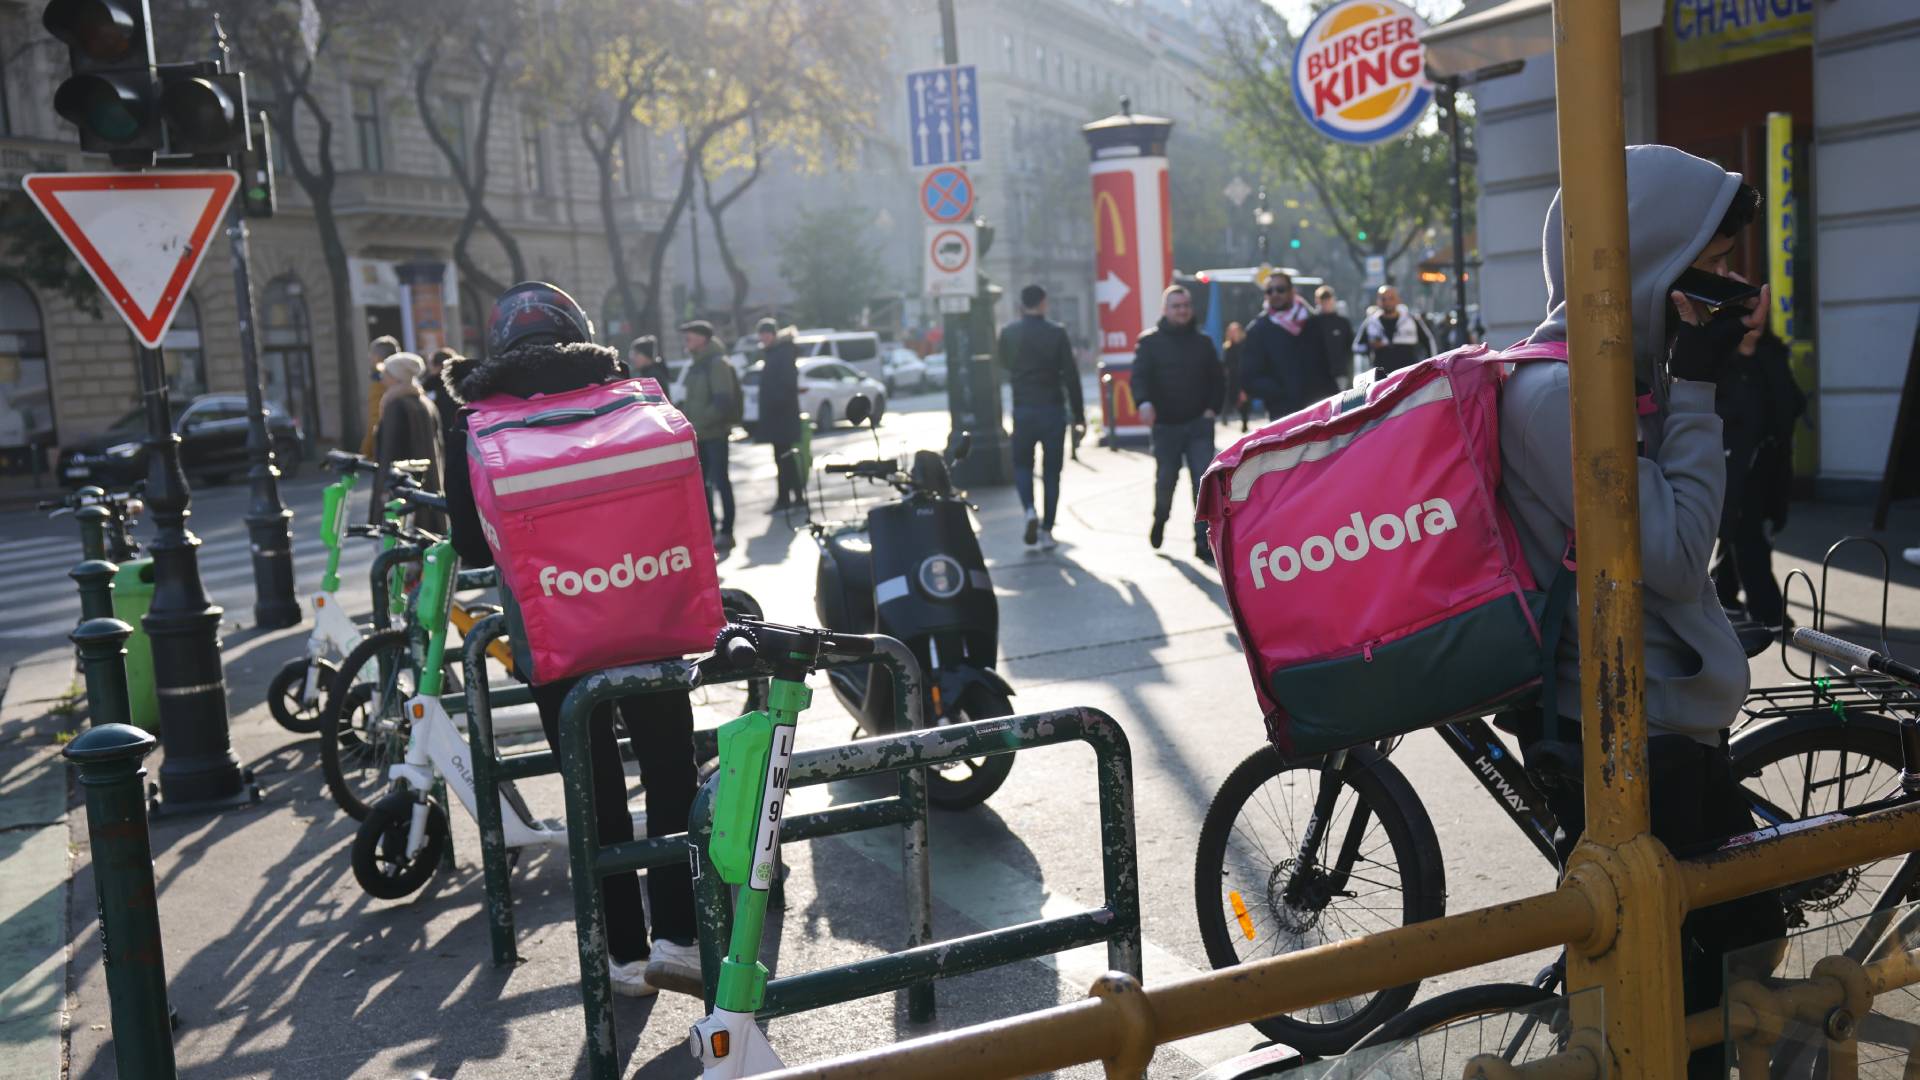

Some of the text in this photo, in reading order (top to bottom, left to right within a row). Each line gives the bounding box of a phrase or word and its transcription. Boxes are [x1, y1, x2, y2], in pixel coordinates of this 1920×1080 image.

[1307, 17, 1414, 81] BURGER
[1674, 0, 1812, 42] CHAN
[1314, 42, 1420, 117] KING
[539, 546, 692, 597] foodora
[1250, 497, 1458, 590] foodora
[1475, 756, 1530, 812] HITWAY
